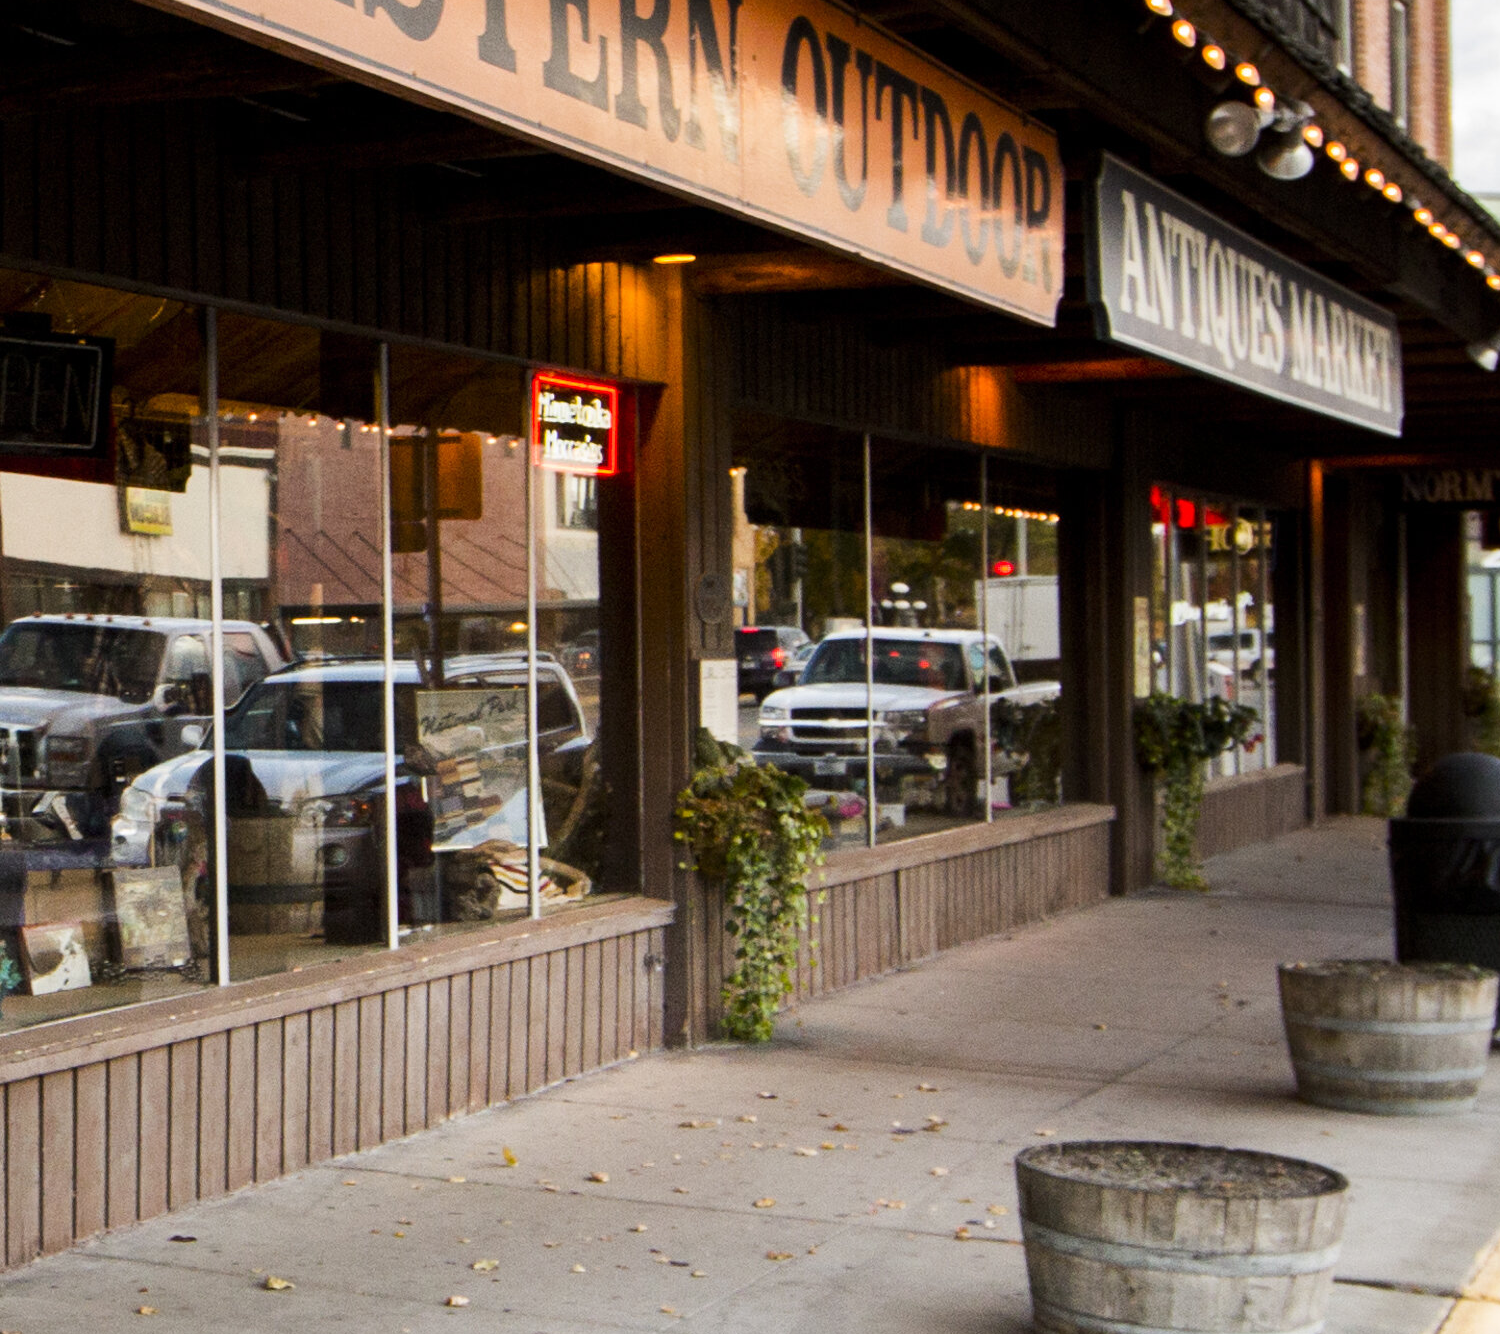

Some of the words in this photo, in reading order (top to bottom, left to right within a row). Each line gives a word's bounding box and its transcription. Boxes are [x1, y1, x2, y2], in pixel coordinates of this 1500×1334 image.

[780, 14, 1052, 296] OUTDOOR
[1120, 188, 1286, 376] ANTIQUES
[1289, 279, 1393, 413] MARKET
